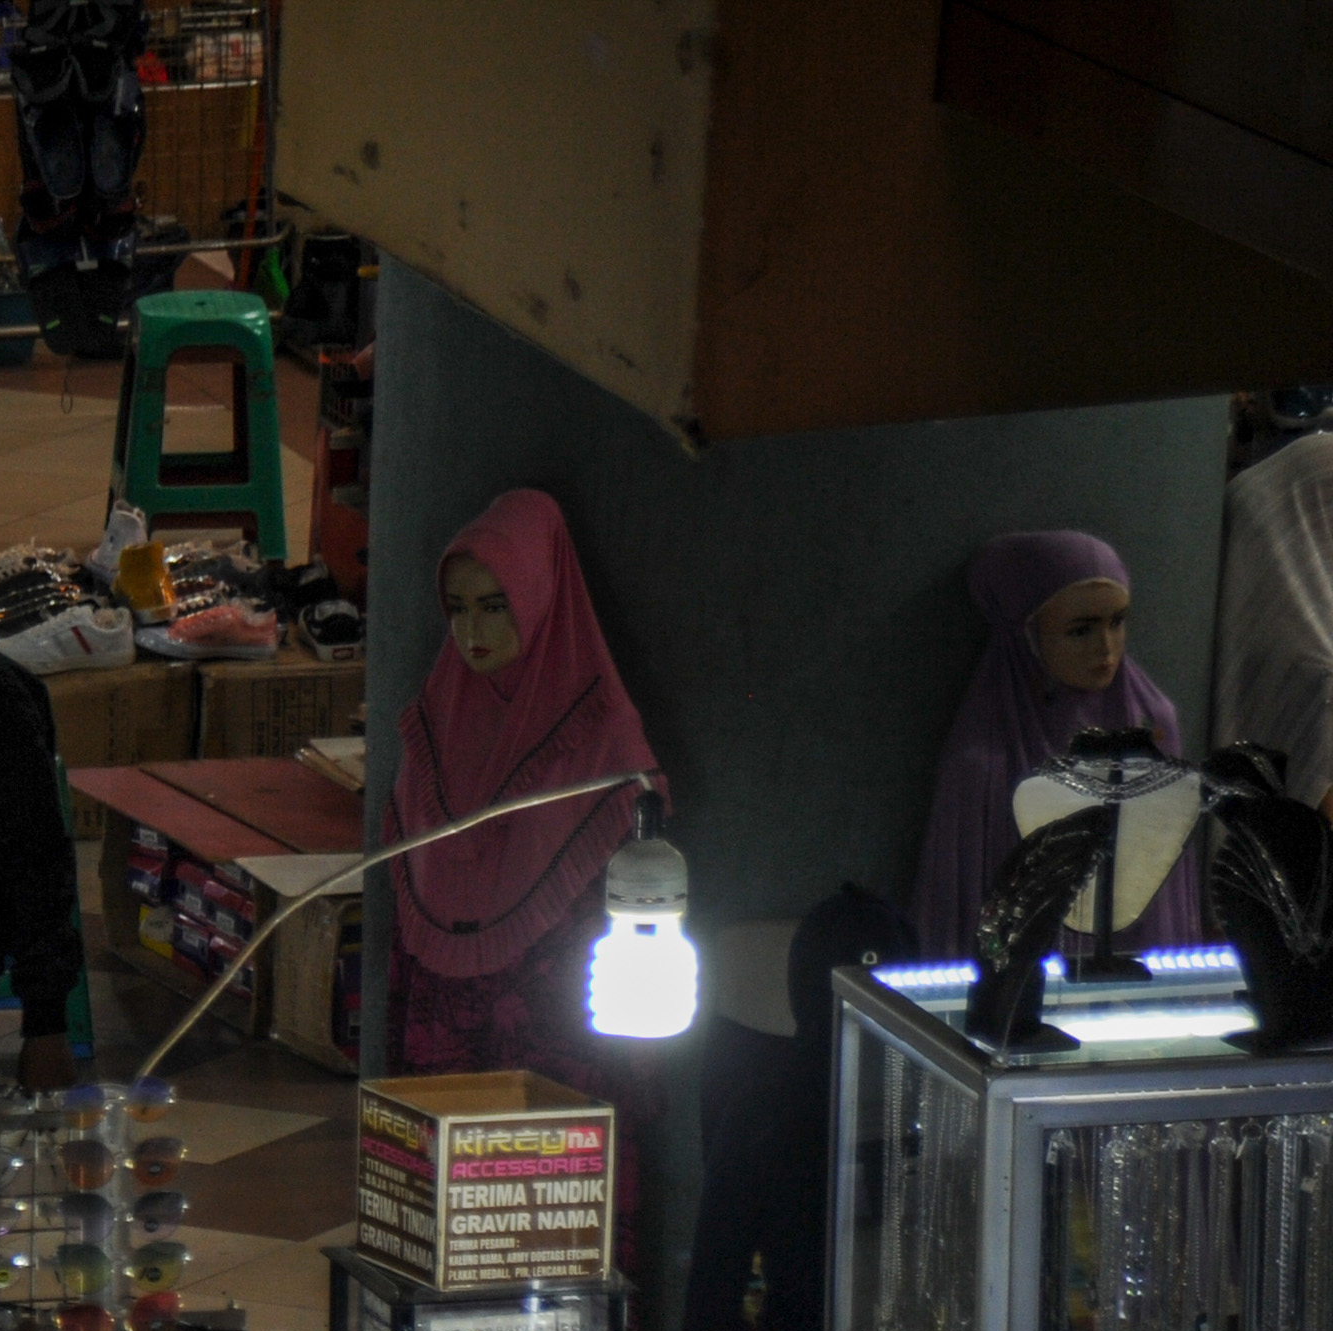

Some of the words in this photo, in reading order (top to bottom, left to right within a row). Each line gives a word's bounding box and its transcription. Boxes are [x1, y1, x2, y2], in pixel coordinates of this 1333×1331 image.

[452, 1156, 603, 1180] ACCESSORIES
[359, 1188, 399, 1228] TERIMA
[449, 1184, 527, 1210] TERIMA
[533, 1179, 605, 1205] TINDIK
[452, 1212, 531, 1236] GRAVIR
[537, 1209, 599, 1231] NAMA
[360, 1221, 401, 1259] GRAVIR
[403, 1239, 434, 1275] NAMA
